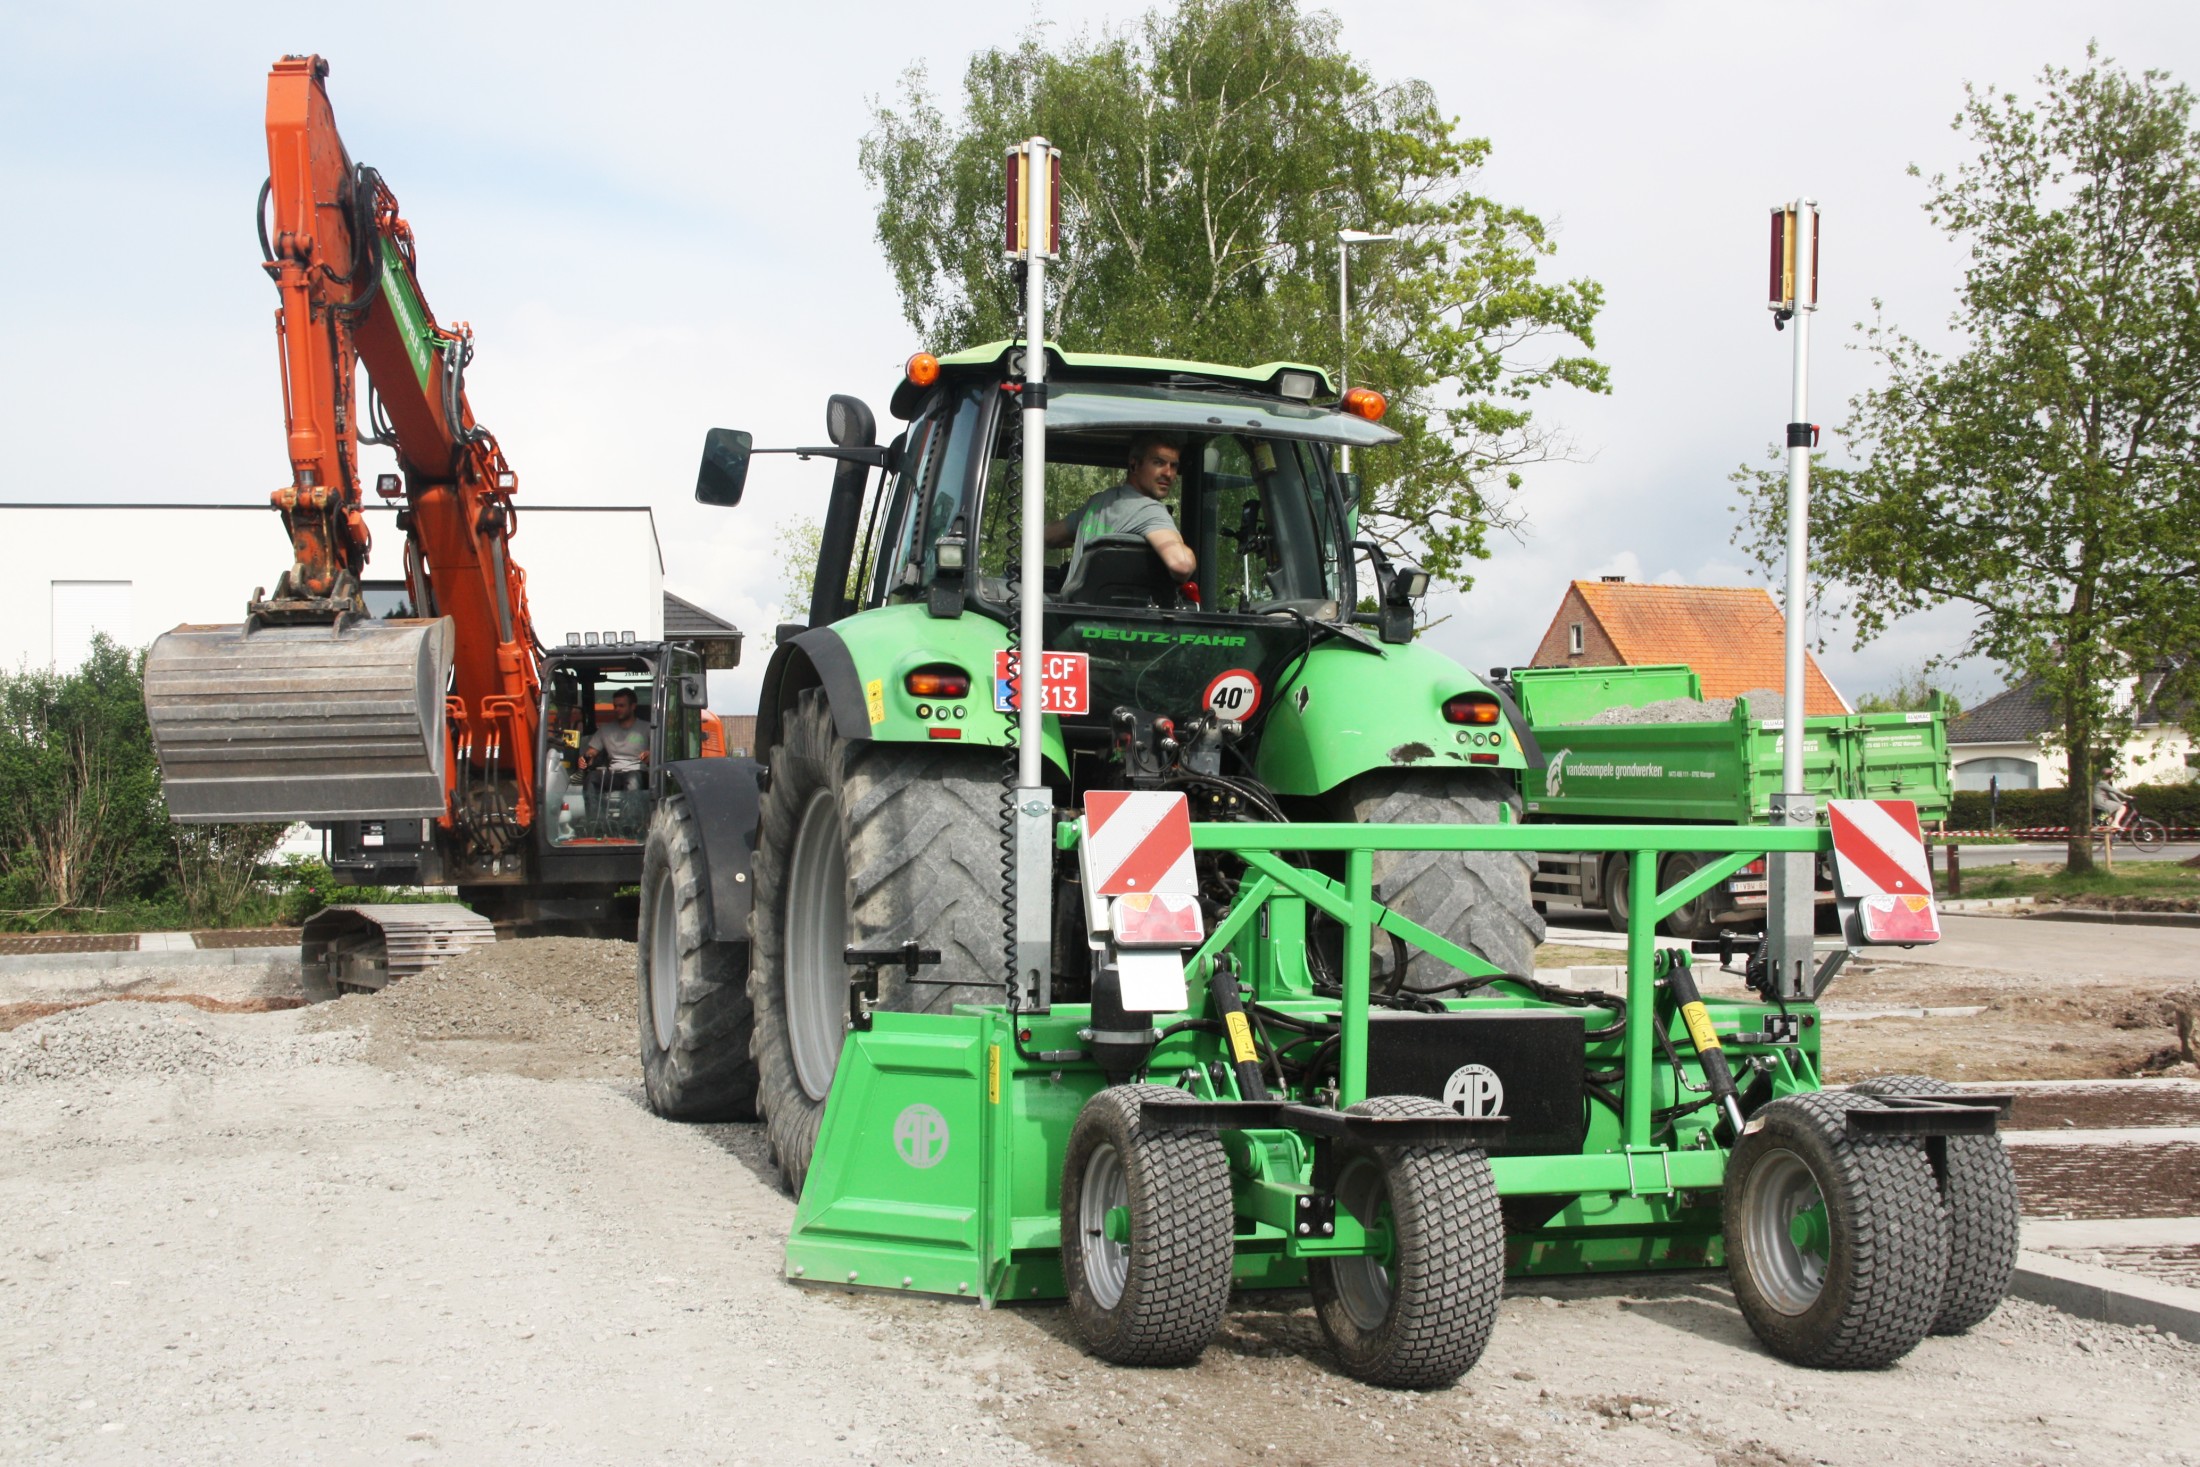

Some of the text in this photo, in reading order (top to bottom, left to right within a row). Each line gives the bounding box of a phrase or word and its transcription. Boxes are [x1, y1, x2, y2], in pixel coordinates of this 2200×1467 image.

[1082, 627, 1247, 647] DEUTZ-FAHR
[1212, 687, 1243, 710] 40
[1566, 762, 1663, 780] vandesompele grondwerken
[1454, 1066, 1494, 1079] SINDS 1979
